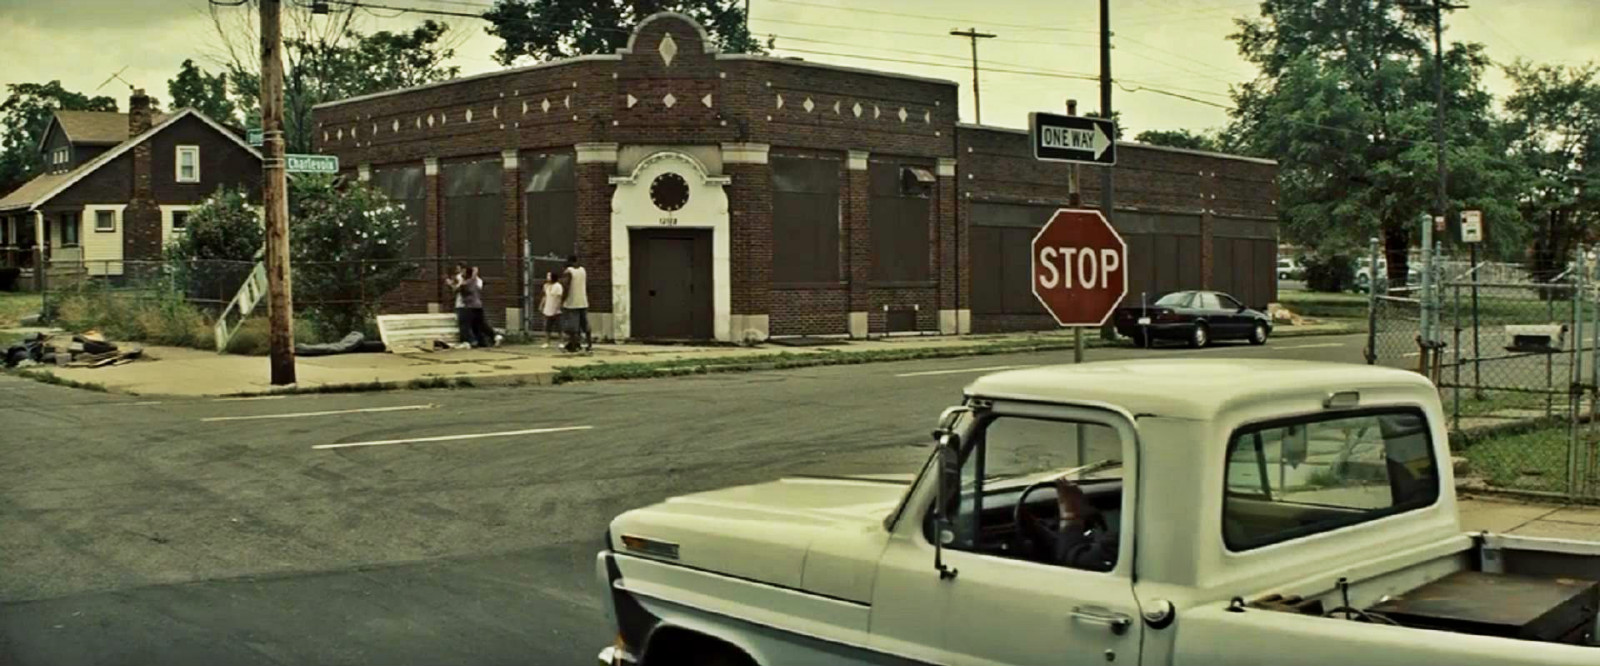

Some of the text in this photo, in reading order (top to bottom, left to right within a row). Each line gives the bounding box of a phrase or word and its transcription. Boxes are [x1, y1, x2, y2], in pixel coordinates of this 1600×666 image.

[1044, 128, 1095, 149] ONE WAY
[288, 157, 334, 170] Charlevoix
[1039, 246, 1119, 289] STOP
